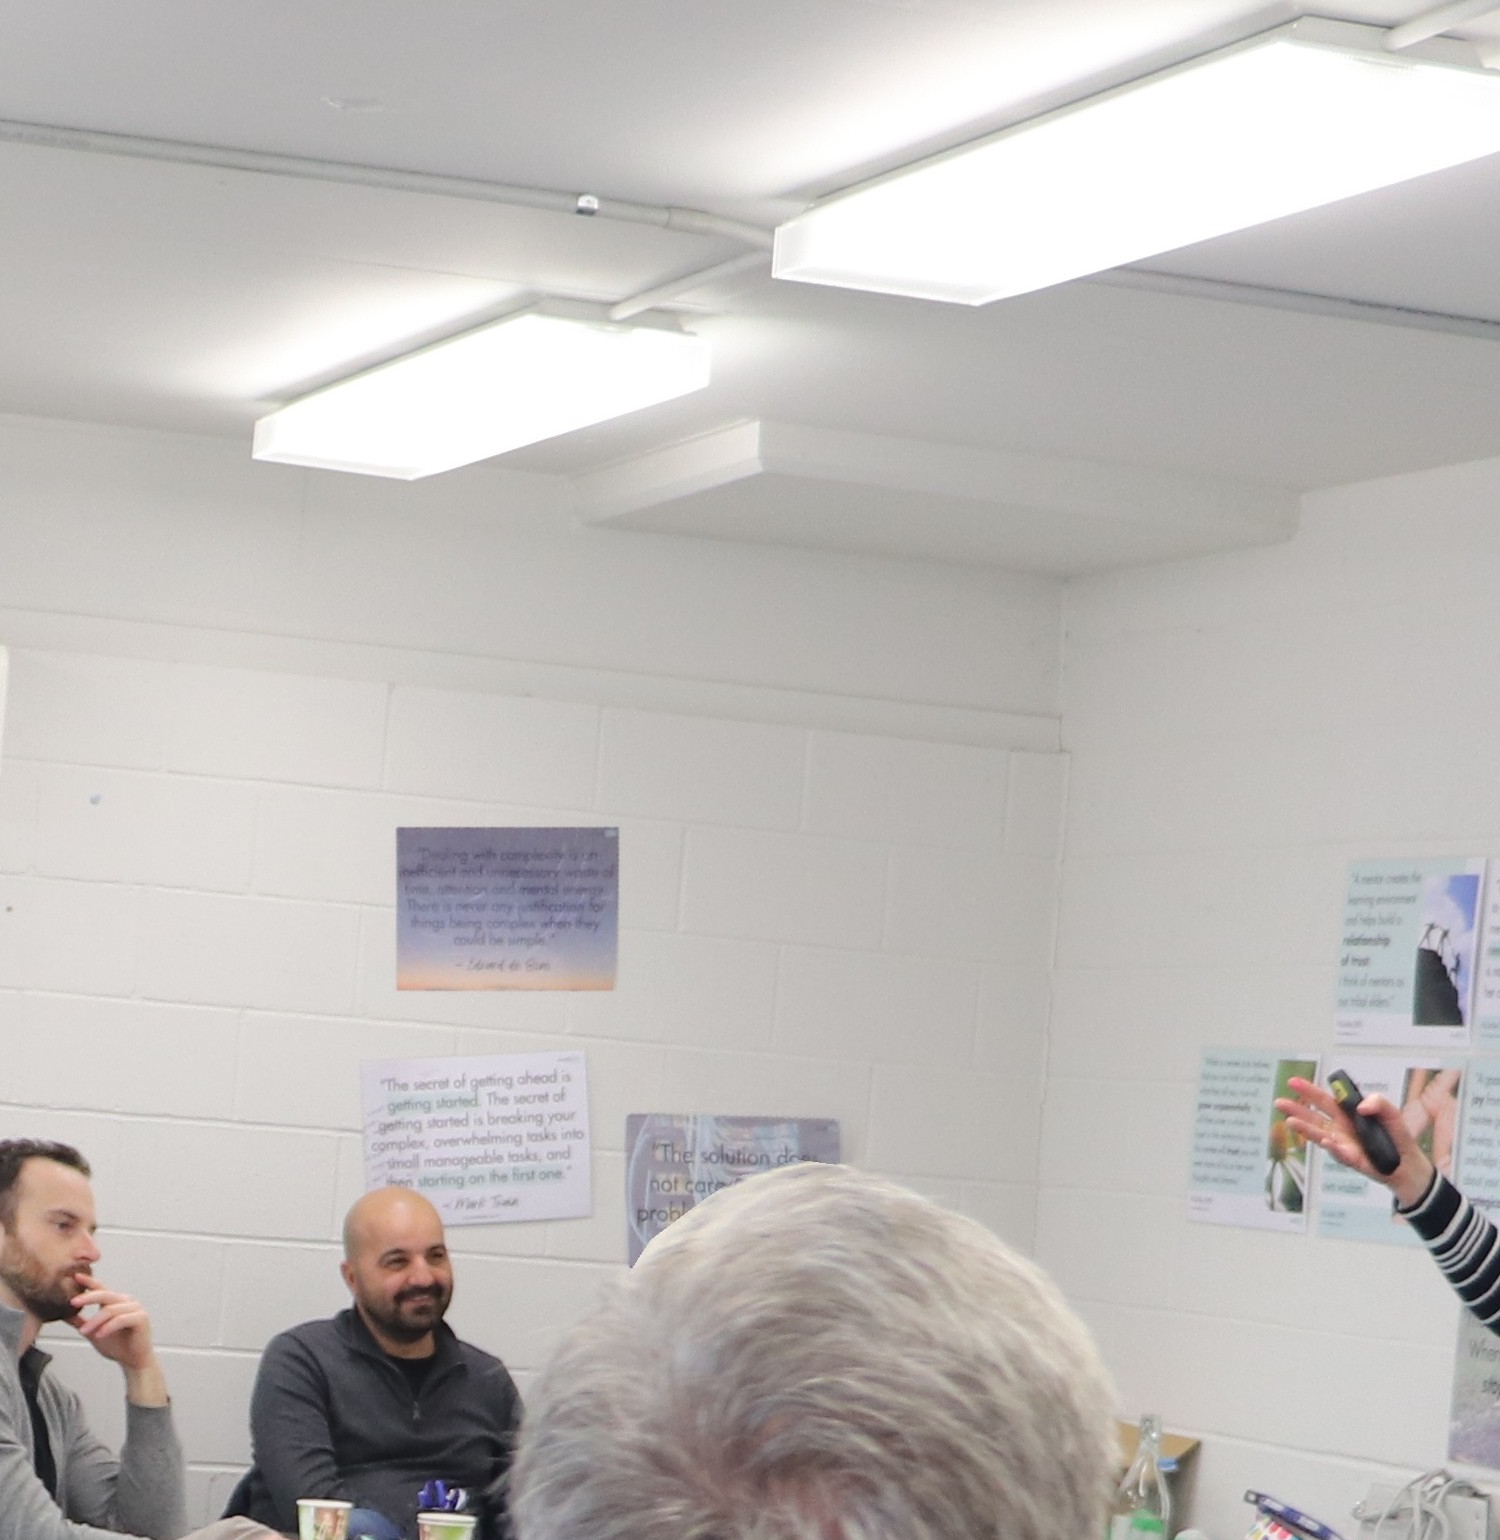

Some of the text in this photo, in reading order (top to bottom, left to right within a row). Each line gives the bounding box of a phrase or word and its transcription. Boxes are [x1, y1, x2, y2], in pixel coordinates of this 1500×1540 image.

[414, 1077, 449, 1091] secret
[453, 1073, 466, 1089] of
[470, 1074, 514, 1094] getting
[517, 1068, 557, 1086] ahead
[560, 1070, 572, 1083] is
[387, 1099, 431, 1116] getting
[486, 1092, 510, 1107] The
[514, 1092, 548, 1105] secret
[552, 1086, 566, 1102] of
[378, 1108, 577, 1136] getting started is breaking your
[433, 1131, 522, 1153] overwhelming
[526, 1127, 557, 1143] tasks
[560, 1128, 584, 1140] into
[386, 1153, 419, 1171] small
[424, 1149, 504, 1170] manageable
[546, 1145, 572, 1162] and
[702, 1144, 770, 1168] solution
[417, 1173, 464, 1191] starting
[469, 1174, 485, 1187] on
[488, 1170, 508, 1184] the
[512, 1168, 536, 1183] first
[650, 1176, 680, 1194] not
